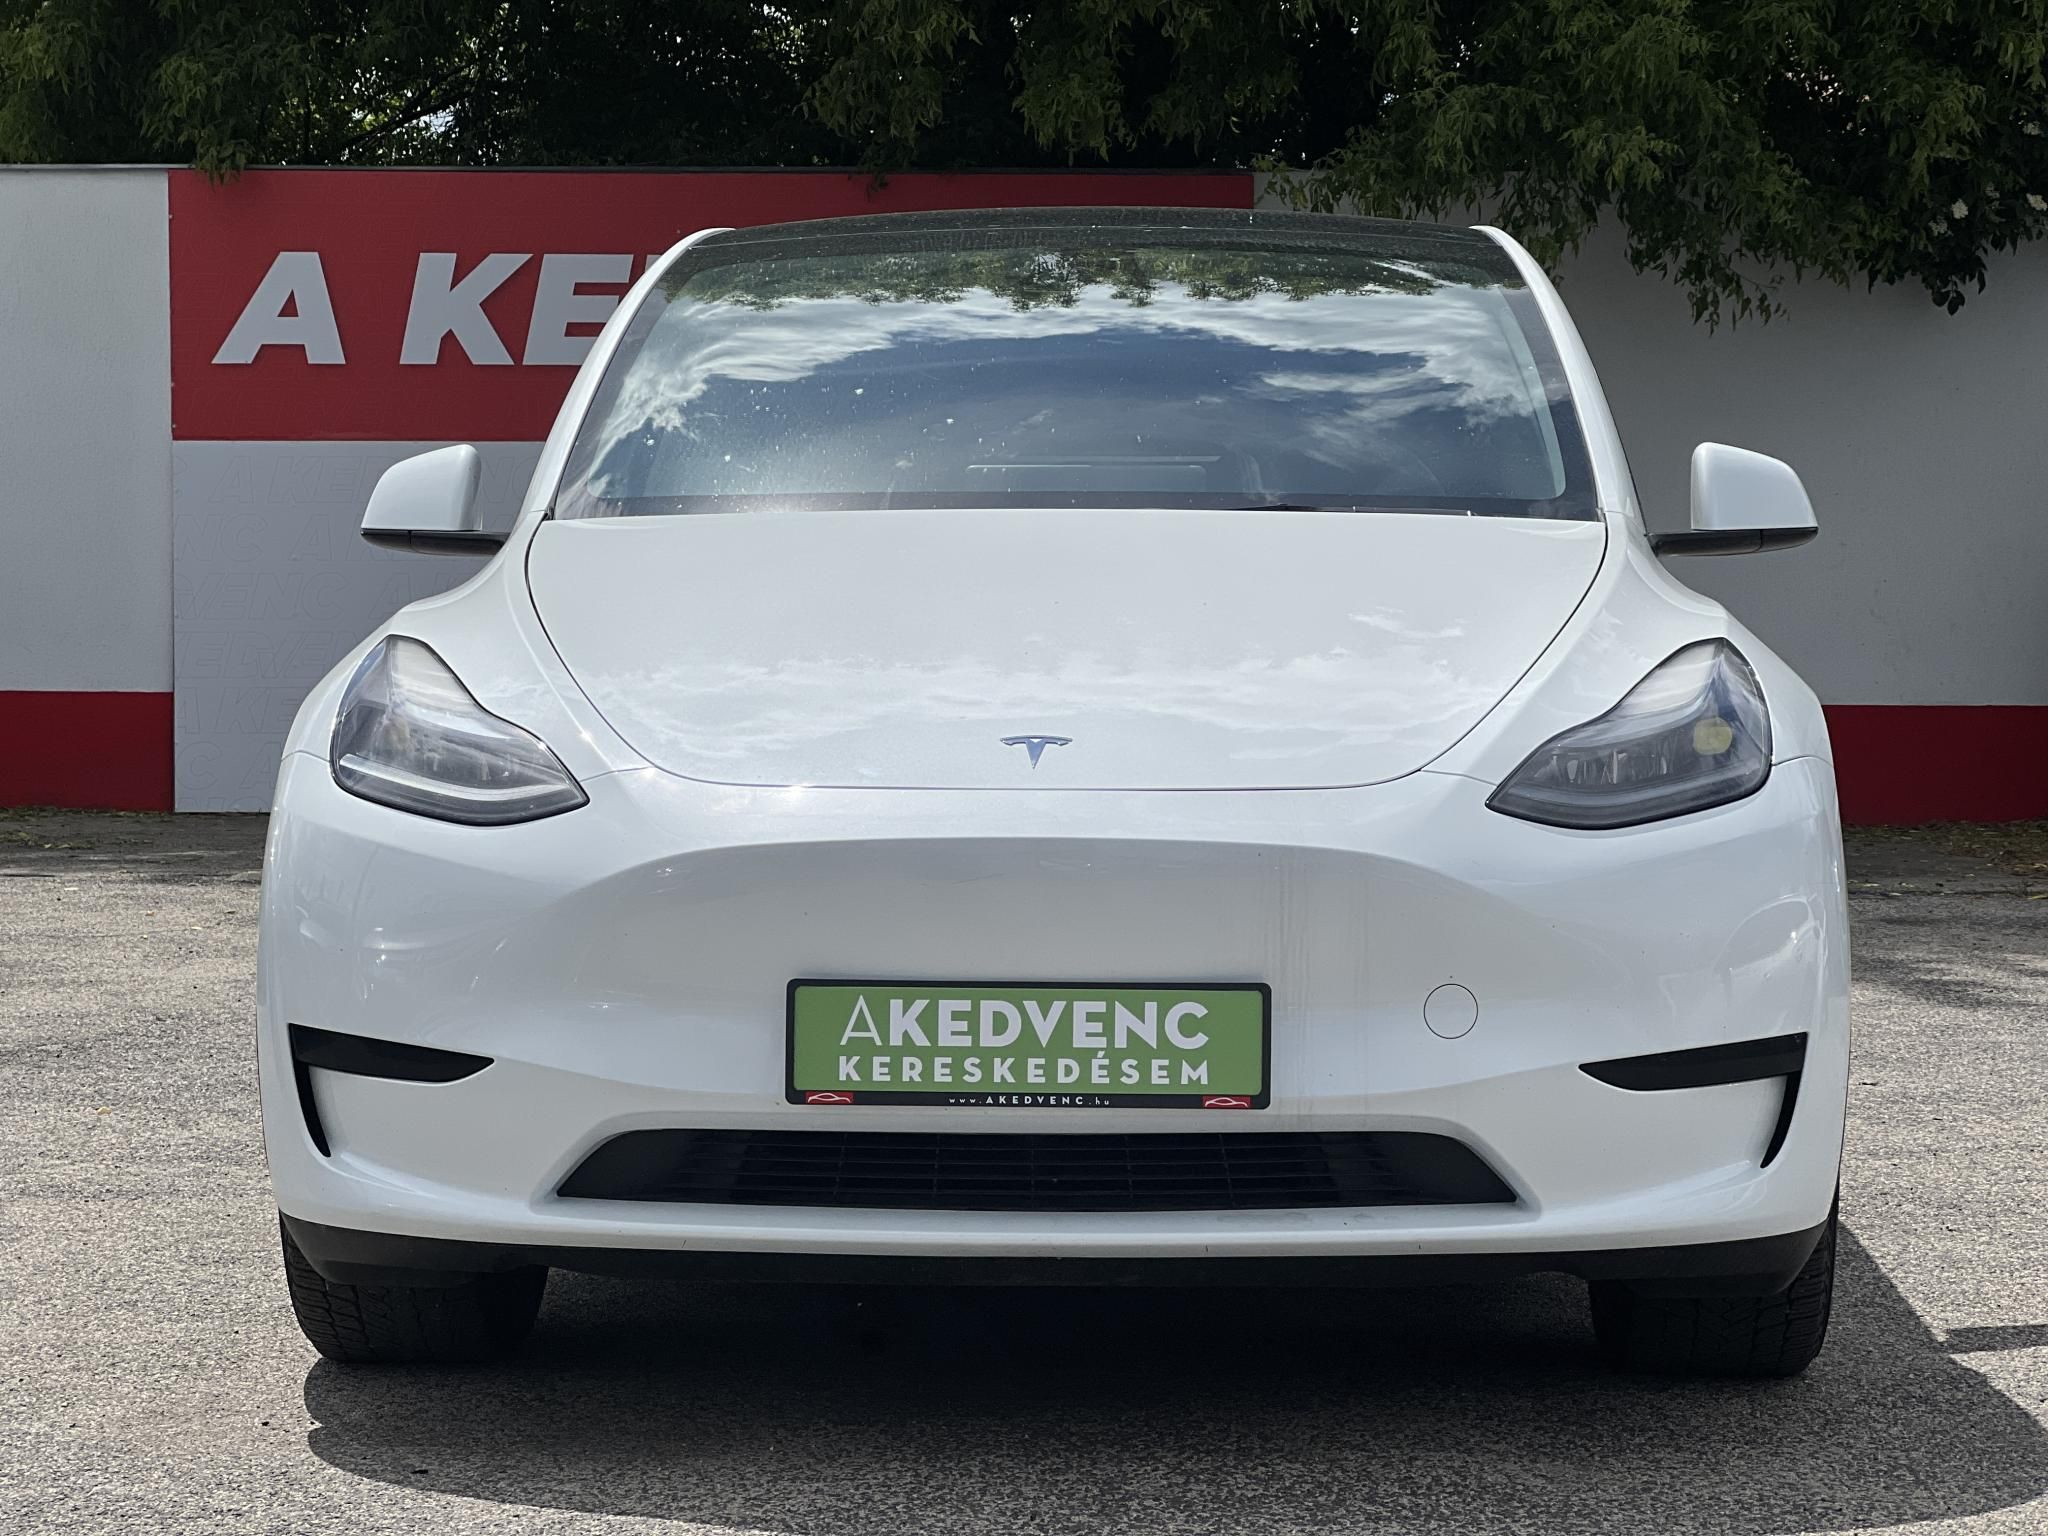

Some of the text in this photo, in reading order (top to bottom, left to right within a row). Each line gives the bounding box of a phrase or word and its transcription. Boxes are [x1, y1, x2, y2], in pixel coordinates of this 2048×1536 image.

[211, 251, 662, 366] A KE
[839, 994, 1210, 1050] AKEDVENC
[838, 1051, 1210, 1086] KERESKEDÉSEM
[948, 1095, 1110, 1106] www.AKEDVENC.hu
